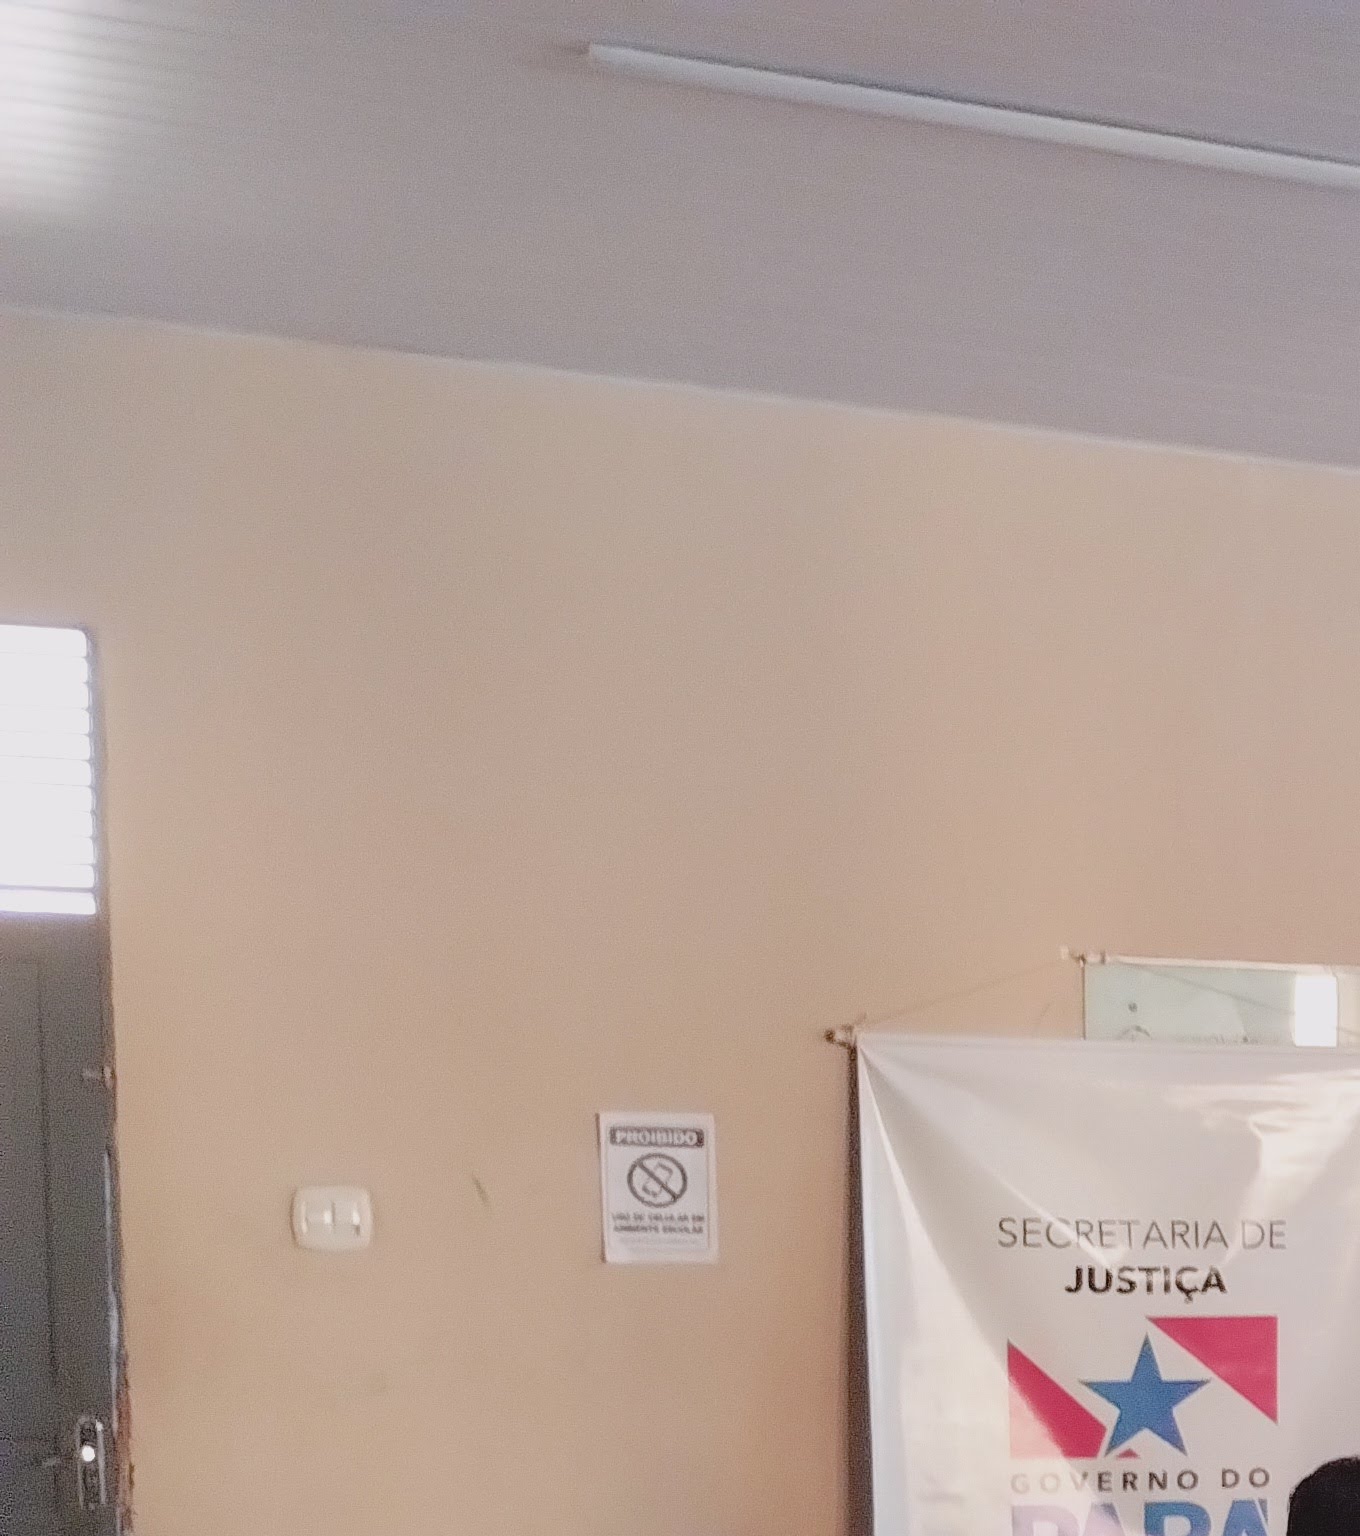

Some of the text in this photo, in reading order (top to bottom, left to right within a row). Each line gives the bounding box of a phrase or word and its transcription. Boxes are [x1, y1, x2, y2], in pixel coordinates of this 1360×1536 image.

[614, 1128, 699, 1147] PROIBIDO
[997, 1216, 1288, 1250] SECRETARIA DE
[1063, 1265, 1228, 1304] JUSTIÇA
[1010, 1467, 1270, 1495] GOVERNO DO
